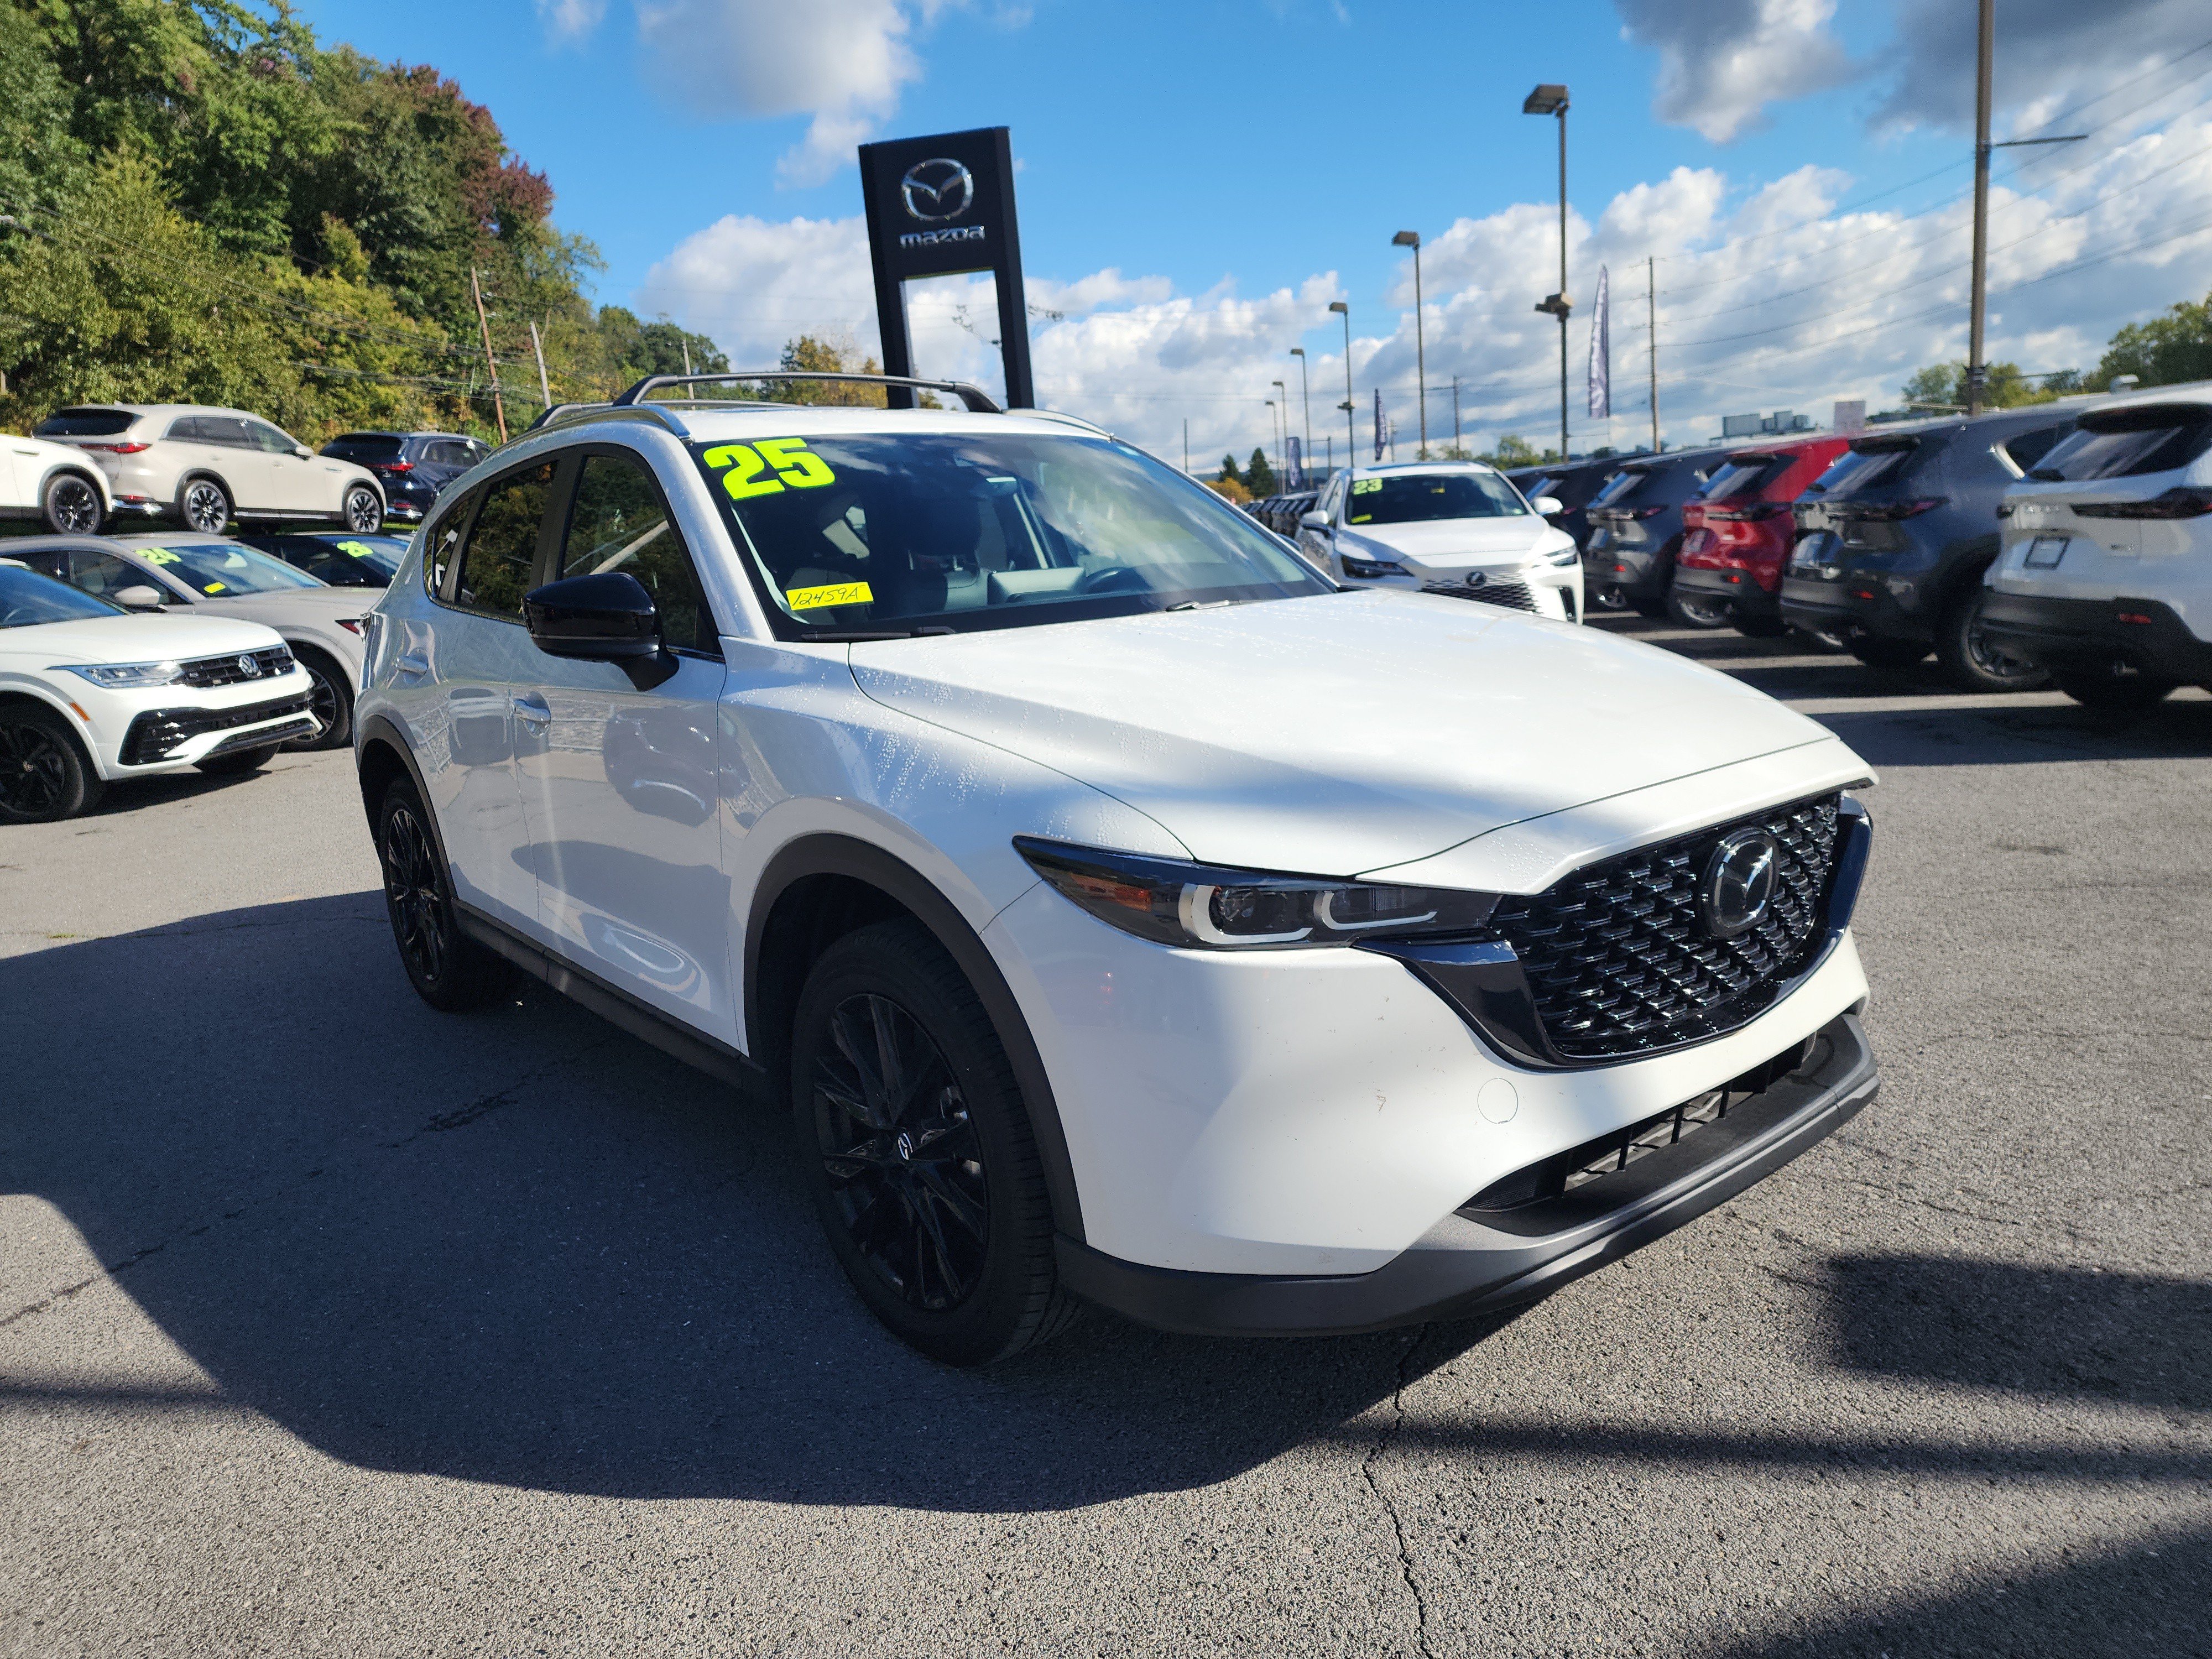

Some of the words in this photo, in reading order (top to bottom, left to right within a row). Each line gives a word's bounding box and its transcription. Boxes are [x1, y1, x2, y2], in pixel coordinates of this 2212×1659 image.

[900, 225, 985, 248] mazda
[703, 437, 835, 500] 25
[1353, 478, 1383, 495] 23
[135, 547, 182, 565] 24
[792, 587, 858, 606] 12459A
